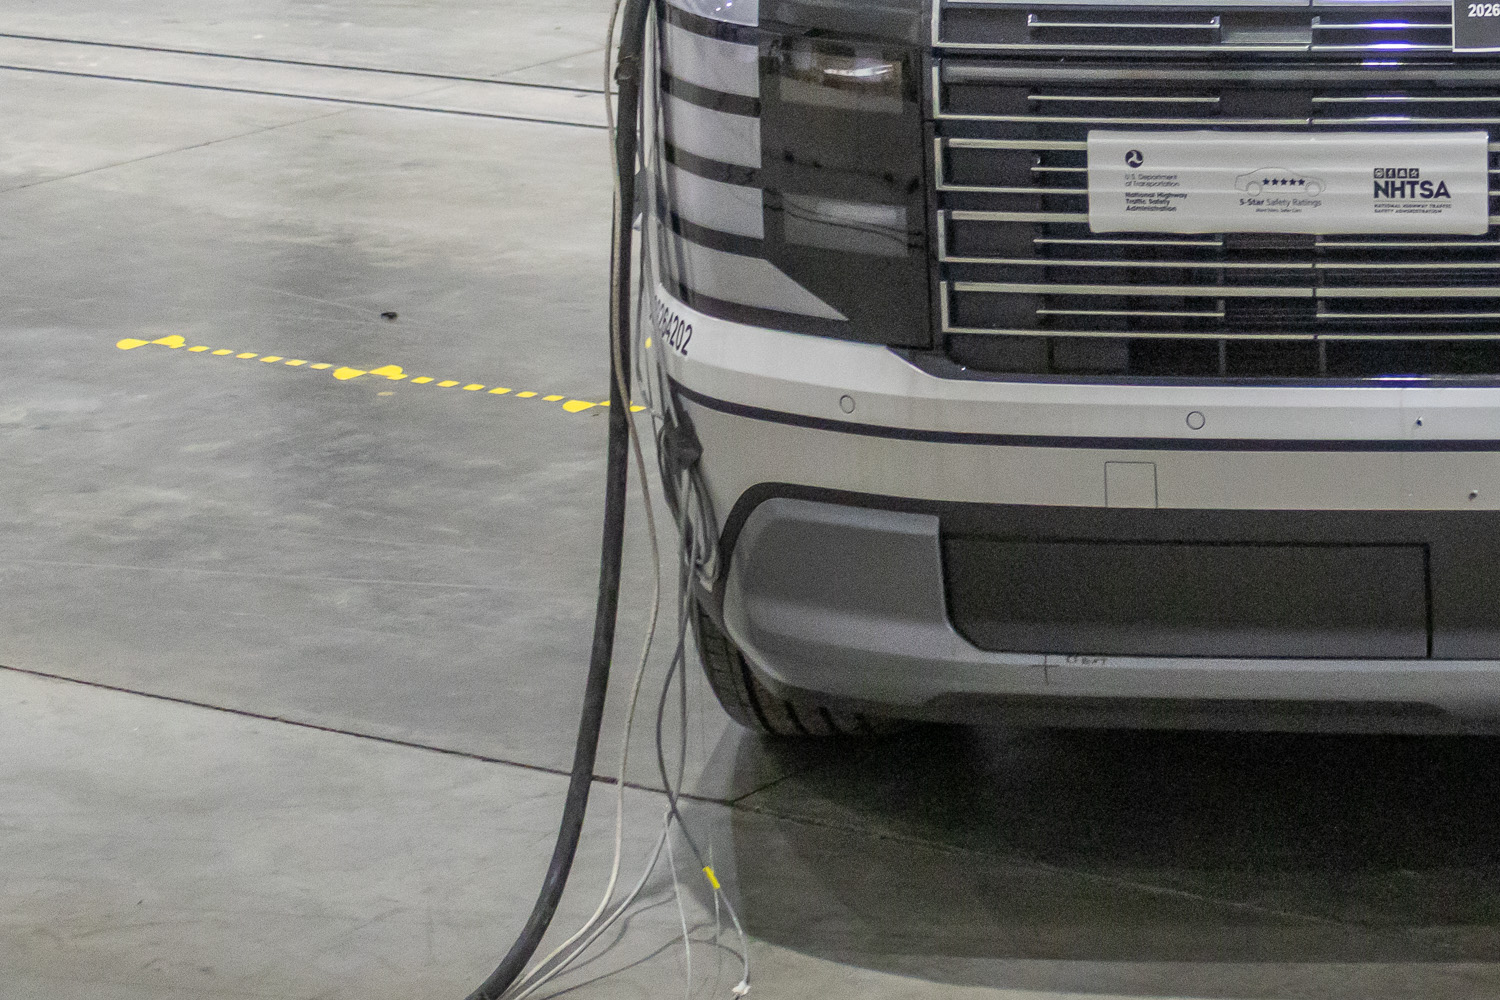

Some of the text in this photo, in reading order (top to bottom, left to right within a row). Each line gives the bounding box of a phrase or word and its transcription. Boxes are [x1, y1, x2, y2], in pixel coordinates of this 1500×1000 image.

[1468, 4, 1500, 17] 2026
[1374, 180, 1451, 198] NHTSA
[1267, 199, 1291, 207] Safety
[1293, 199, 1321, 208] Ratings
